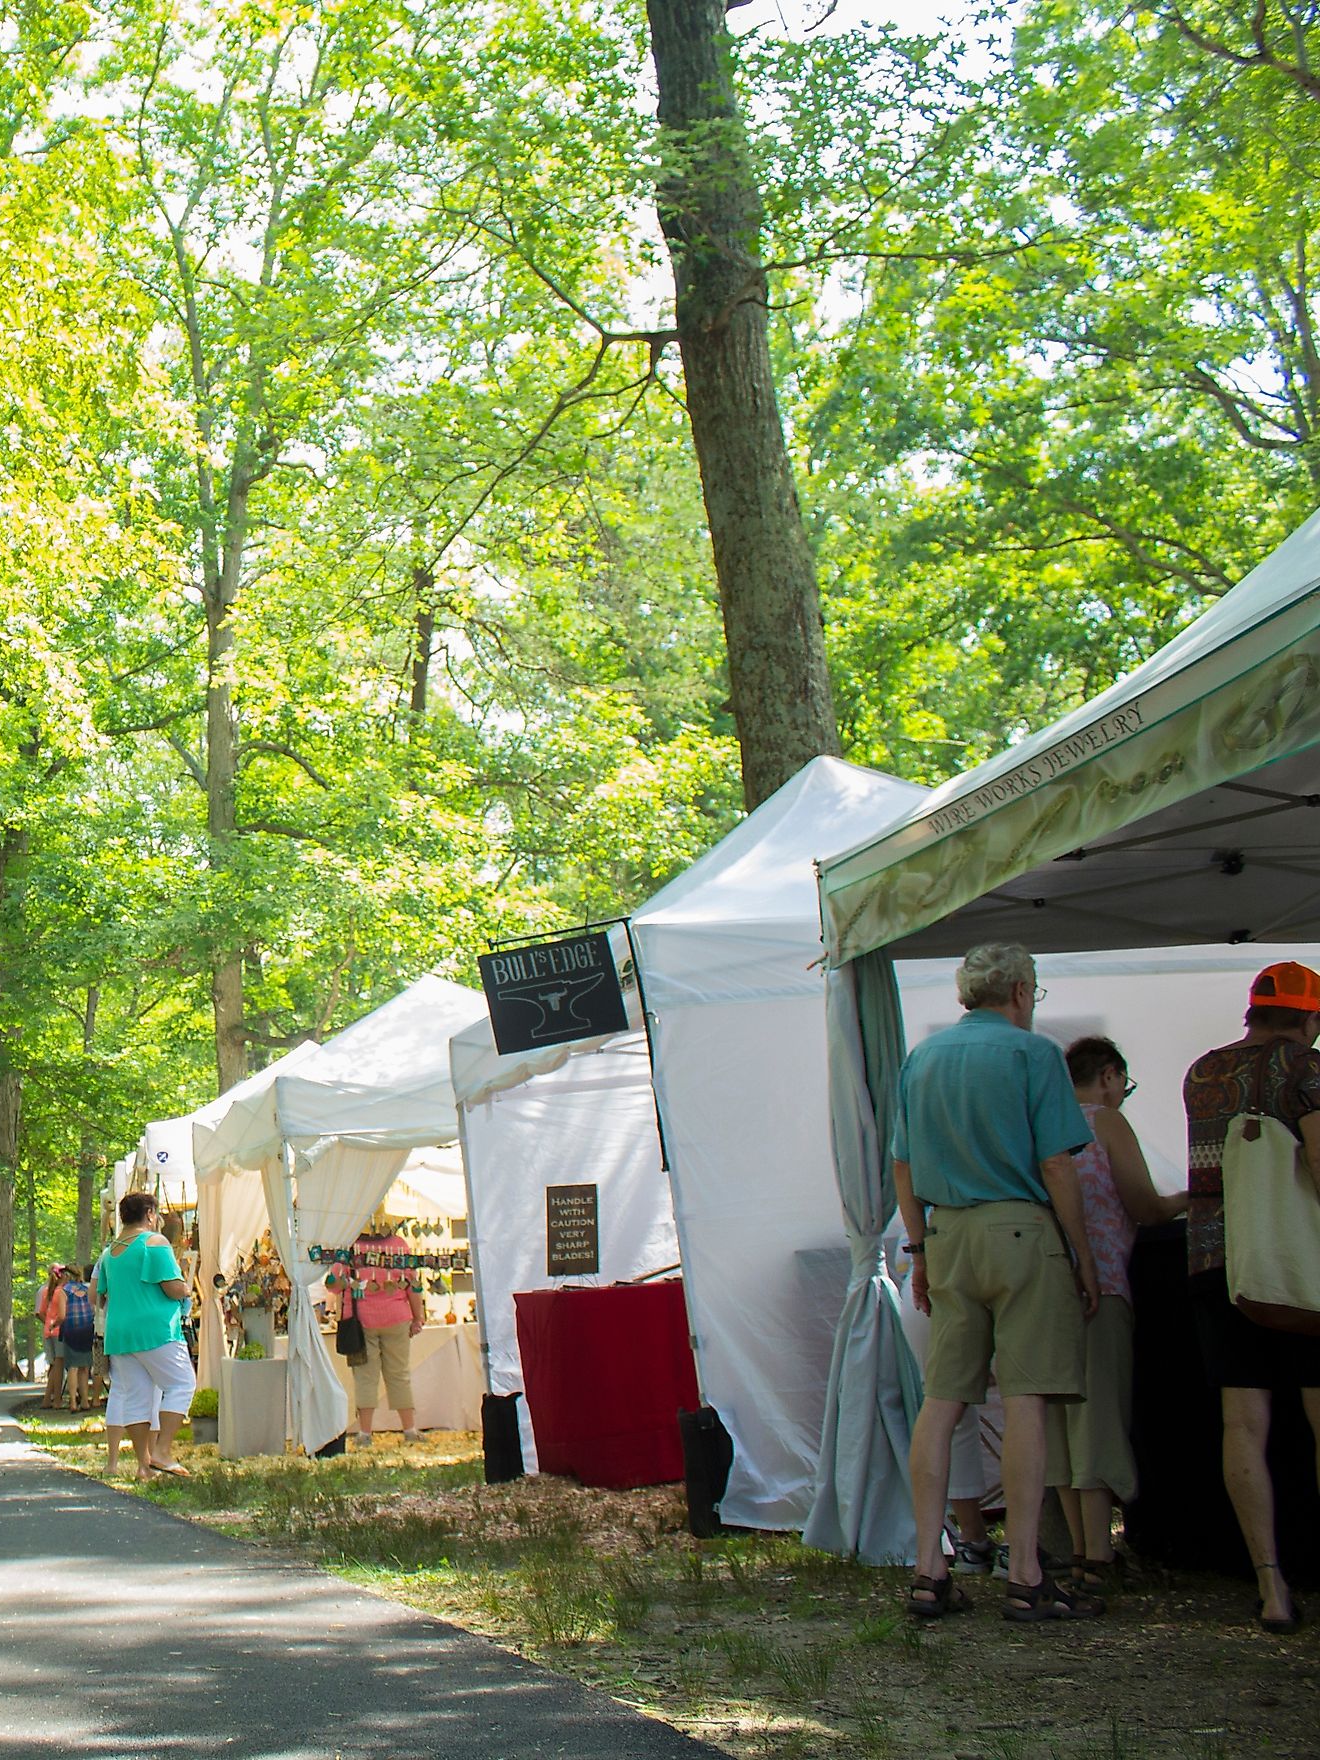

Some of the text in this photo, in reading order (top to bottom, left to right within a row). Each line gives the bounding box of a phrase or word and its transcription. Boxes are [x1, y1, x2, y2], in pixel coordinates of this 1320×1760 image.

[929, 701, 1145, 835] WIRE WORKS JEWELRY
[549, 940, 602, 975] EDGE
[551, 1197, 594, 1206] HANDLE
[560, 1208, 586, 1217] WITH
[550, 1218, 595, 1228] CAUTION
[560, 1230, 586, 1239] VERY
[556, 1241, 590, 1250] SHARP
[552, 1250, 594, 1261] BLADES!
